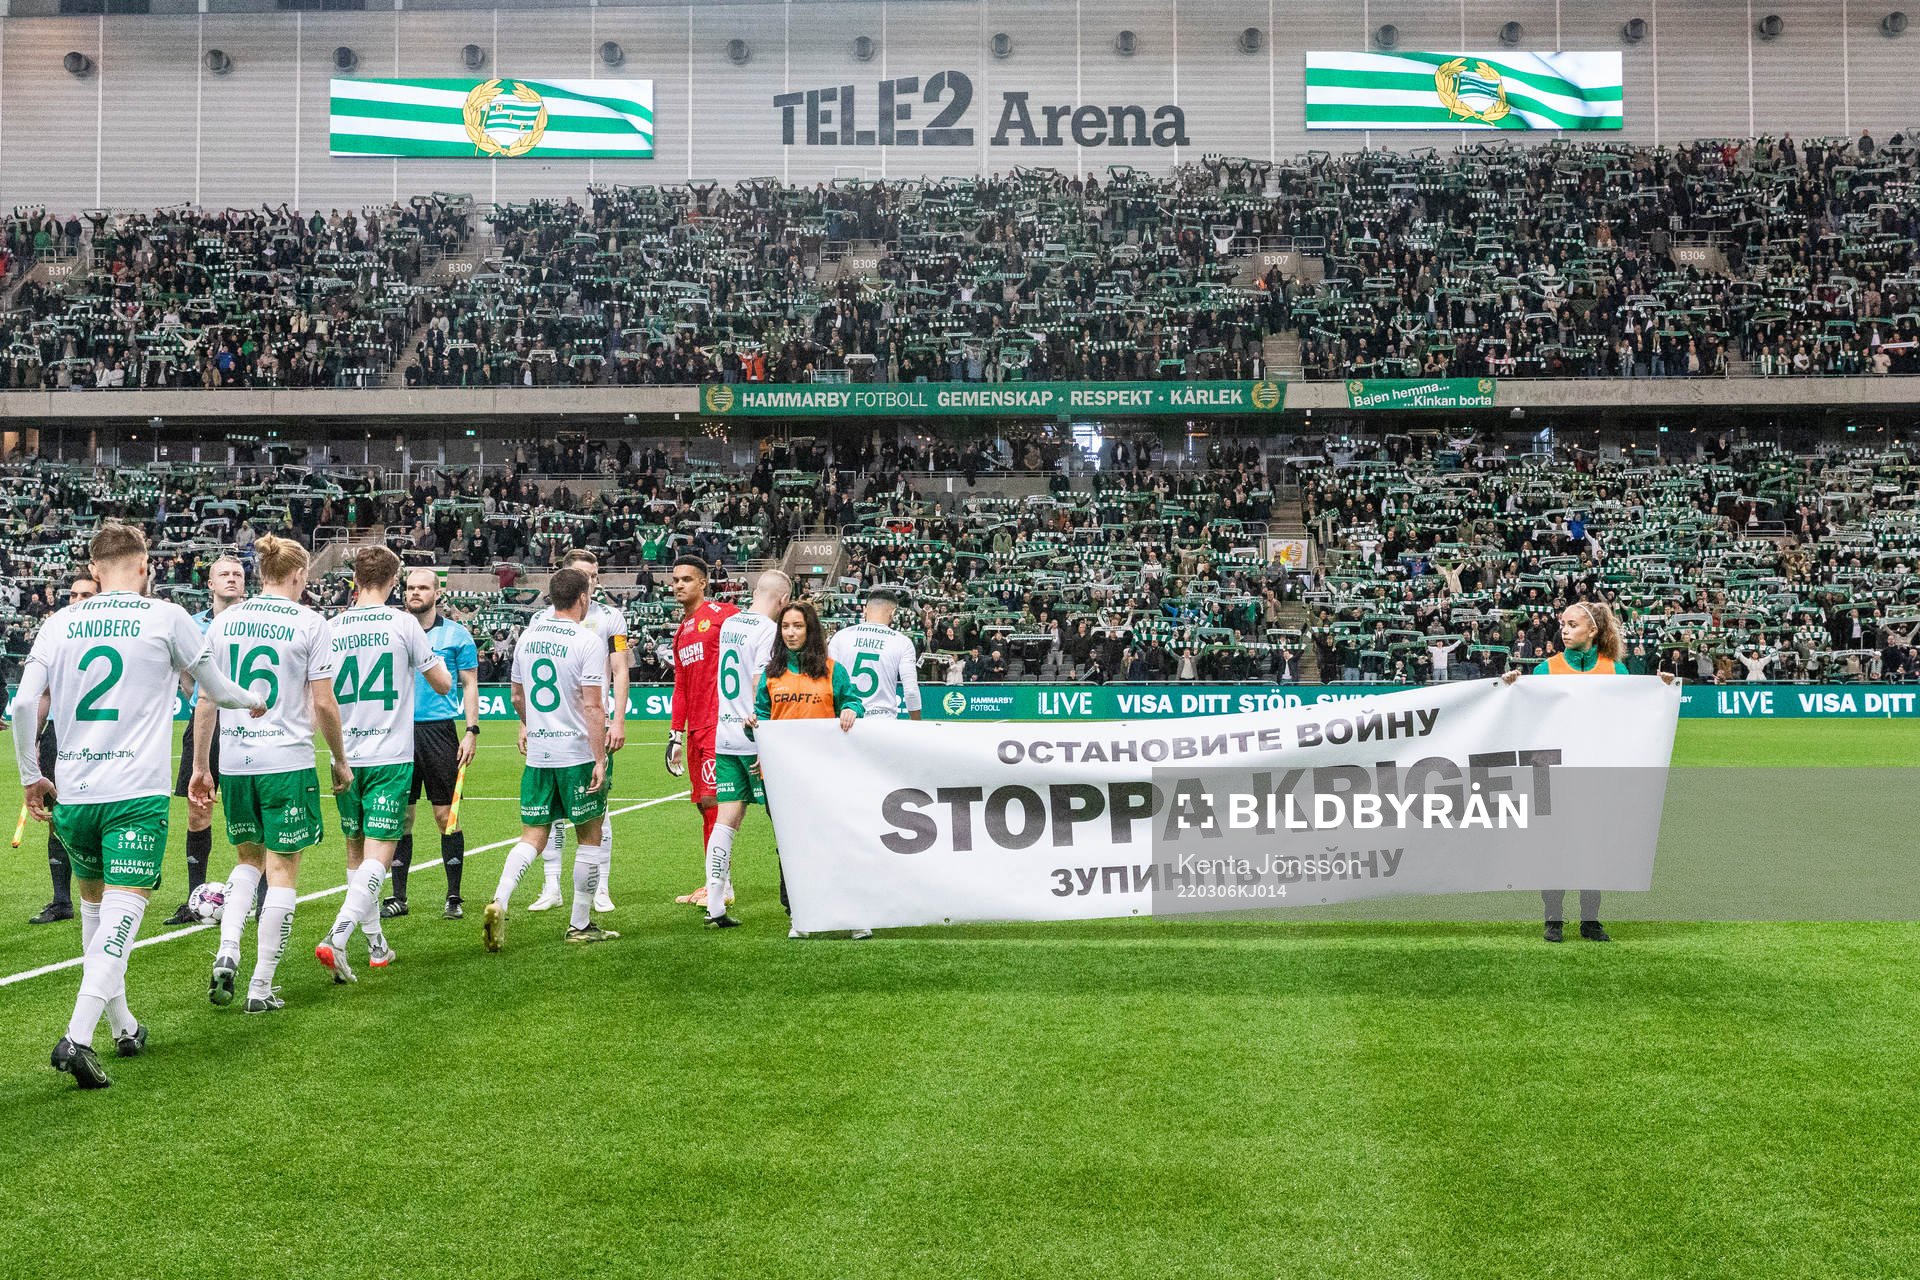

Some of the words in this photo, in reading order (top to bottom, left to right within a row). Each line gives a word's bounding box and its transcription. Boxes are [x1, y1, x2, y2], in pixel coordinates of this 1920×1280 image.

[773, 70, 974, 146] TELE2
[990, 92, 1190, 147] Arena
[853, 259, 877, 269] B308
[1264, 255, 1288, 265] B307
[1680, 251, 1706, 261] B306
[48, 266, 72, 276] B310
[448, 263, 473, 273] B309
[742, 392, 851, 407] HAMMARBY
[855, 392, 928, 407] FOTBOLL
[937, 391, 1054, 407] GEMENSKAP
[1070, 390, 1153, 406] RESPEKT
[1170, 388, 1243, 405] KÄRLEK
[1354, 393, 1390, 408] Bajen
[1460, 395, 1492, 406] borta
[802, 545, 833, 556] A108
[82, 599, 151, 610] limitado
[242, 602, 299, 616] limitado
[67, 619, 141, 639] SANDBERG
[224, 622, 295, 642] LUDWIGSON
[535, 624, 577, 637] limitado
[856, 625, 897, 637] limitado
[332, 632, 389, 652] SWEDBERG
[525, 641, 568, 658] ANDERSEN
[853, 637, 885, 650] JEAHZE
[75, 645, 124, 721] 2
[230, 644, 280, 710] 16
[333, 652, 398, 711] 44
[720, 649, 740, 700] 6
[851, 652, 880, 698] 5
[530, 658, 561, 713] 8
[773, 693, 812, 703] CRAFT
[1042, 692, 1092, 716] LIVE
[1117, 694, 1169, 713] VISA
[1181, 694, 1231, 713] DITT
[1721, 691, 1773, 715] LIVE
[1798, 693, 1857, 712] VISA
[1864, 693, 1916, 713] DITT
[970, 704, 1001, 712] FOTBOLL
[997, 728, 1282, 765] ОСТАНОВИТЕ
[1296, 708, 1440, 748] ВОЙНУ
[879, 778, 1223, 854] STOPPA
[1251, 749, 1562, 836] KRIGET
[118, 841, 155, 851] STRÅLE
[110, 866, 144, 875] RENOVA
[104, 915, 134, 959] Clinton
